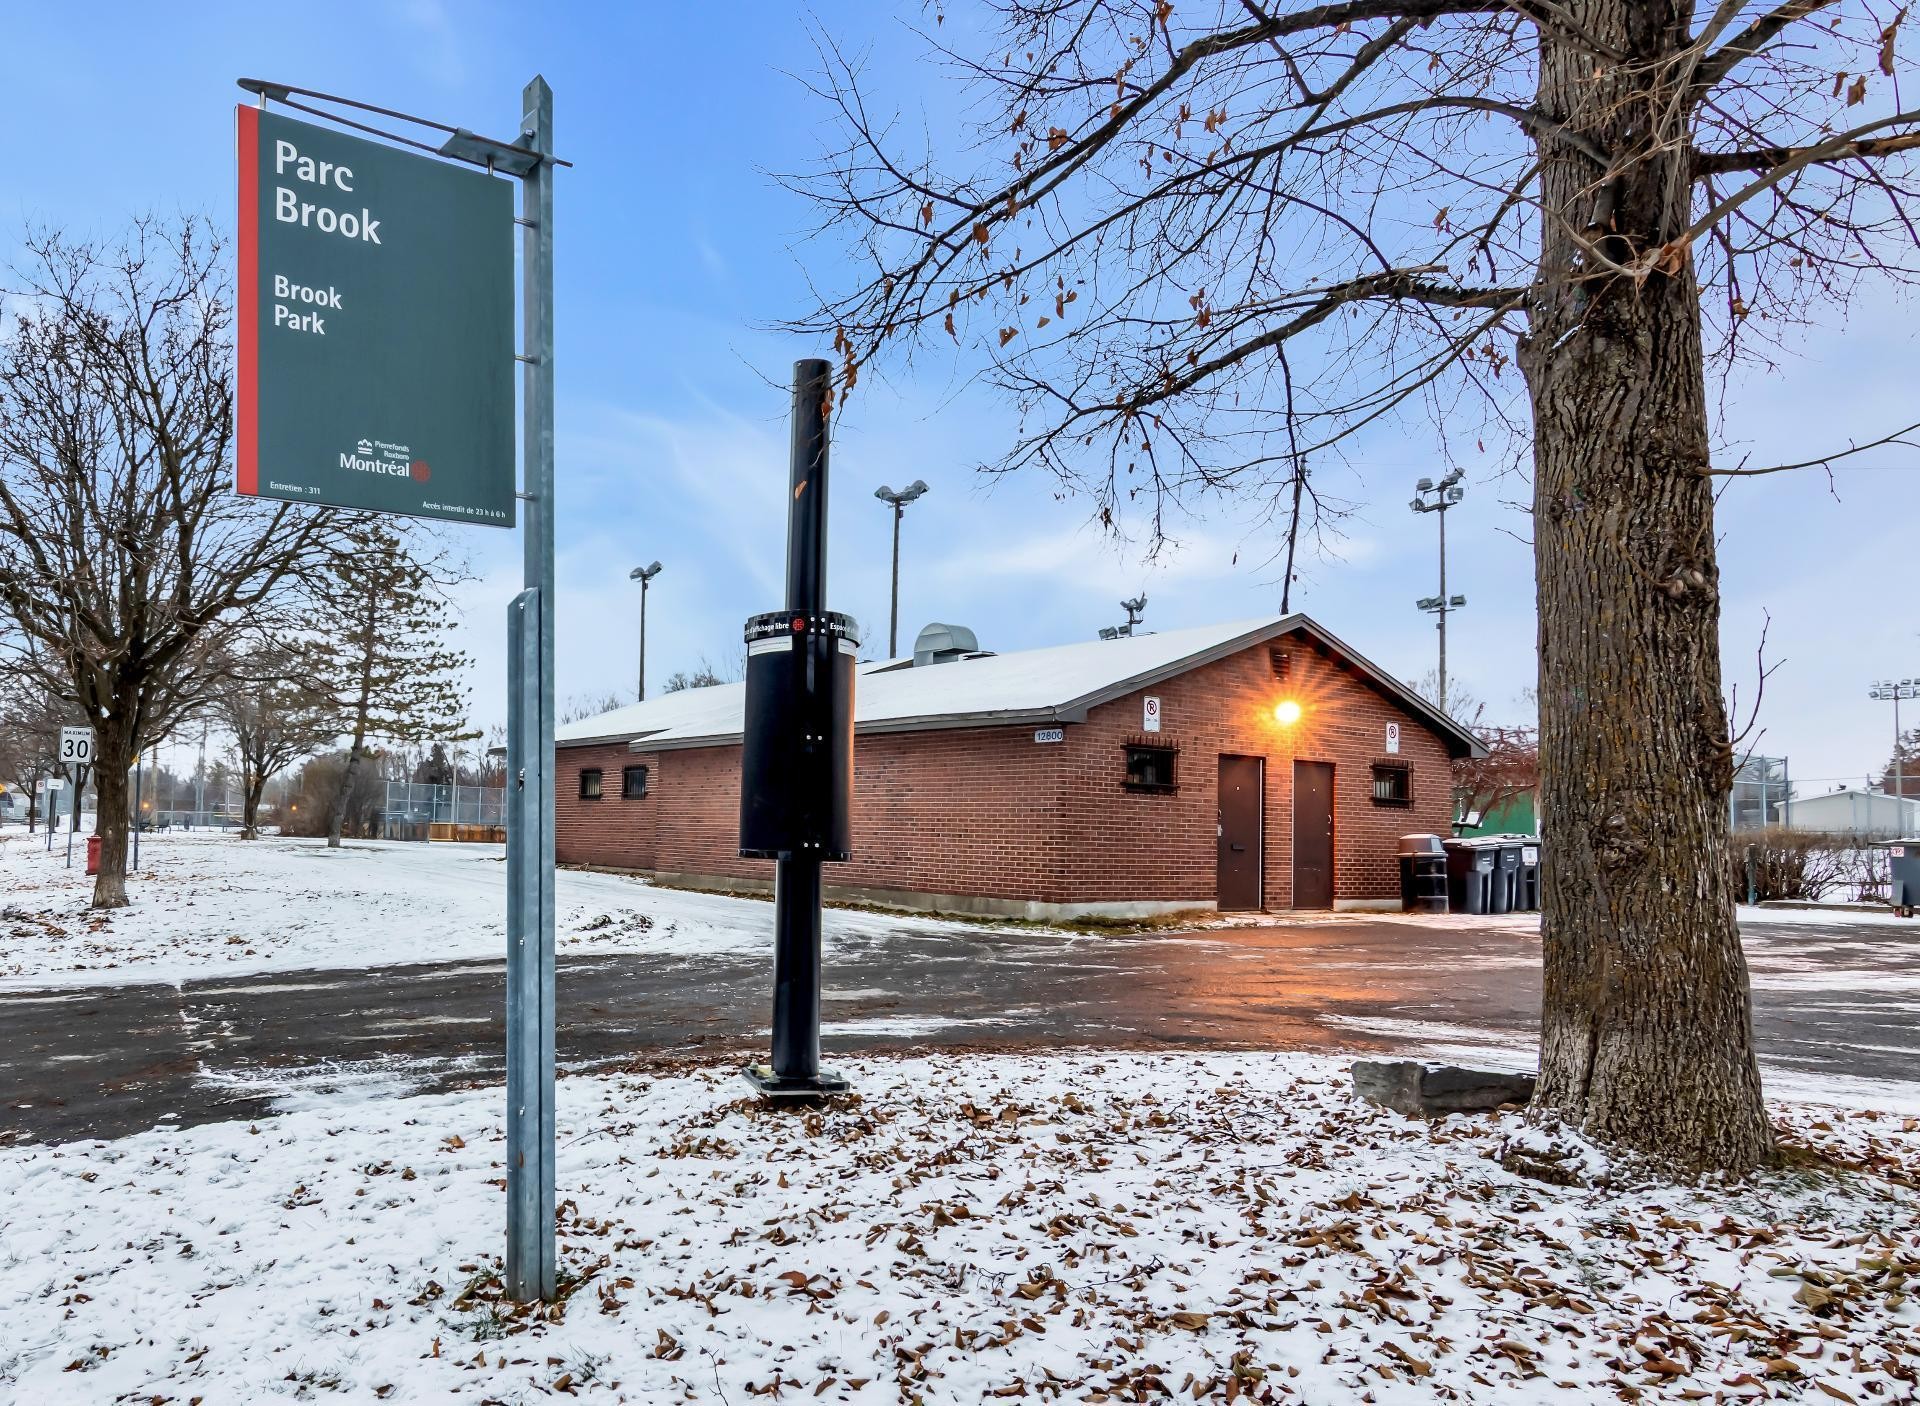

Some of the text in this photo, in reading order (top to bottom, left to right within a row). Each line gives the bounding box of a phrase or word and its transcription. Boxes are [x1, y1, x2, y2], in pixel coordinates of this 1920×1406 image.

[275, 139, 353, 192] Parc
[275, 186, 382, 245] Brook
[274, 274, 343, 310] Brook
[274, 303, 326, 335] Park
[374, 440, 410, 453] Pierrefonds
[340, 452, 410, 478] Montréal
[270, 481, 303, 493] Entretien
[308, 486, 321, 495] 311
[422, 500, 441, 510] Accès
[442, 503, 465, 513] interdit
[466, 506, 474, 515] de
[475, 508, 484, 516] 23
[775, 622, 790, 630] libre
[1038, 731, 1063, 740] 12800
[63, 739, 89, 759] 30
